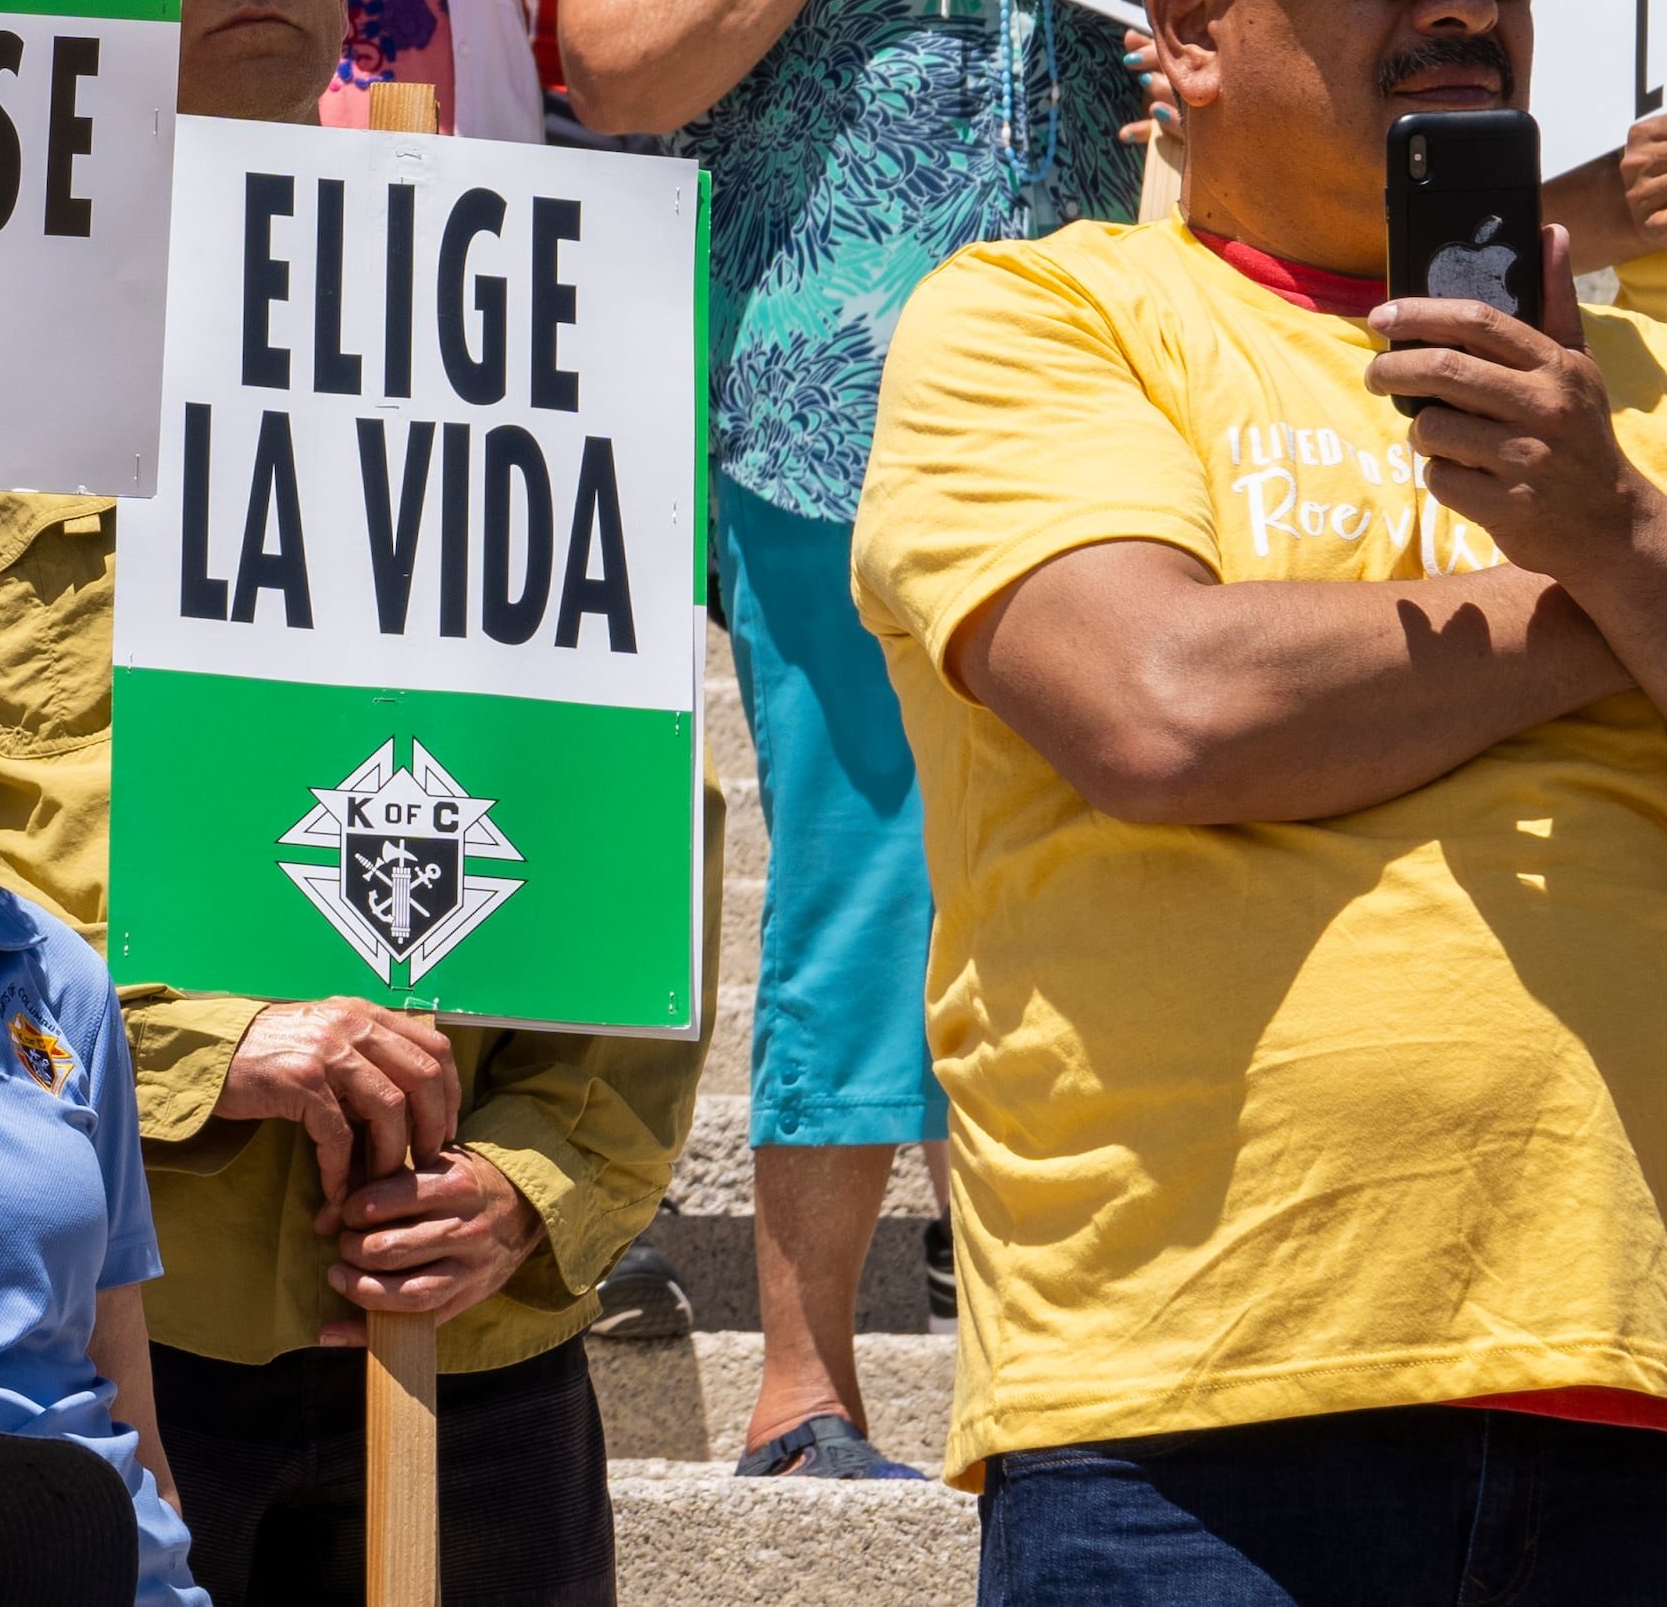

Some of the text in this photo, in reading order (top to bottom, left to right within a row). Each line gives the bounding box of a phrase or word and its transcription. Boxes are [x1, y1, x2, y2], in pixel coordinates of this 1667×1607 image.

[241, 171, 582, 414] ELIGE
[1249, 421, 1344, 466] LIVED
[180, 402, 639, 654] LA VIDA
[1231, 466, 1373, 558] Roe
[347, 796, 460, 834] K OF C
